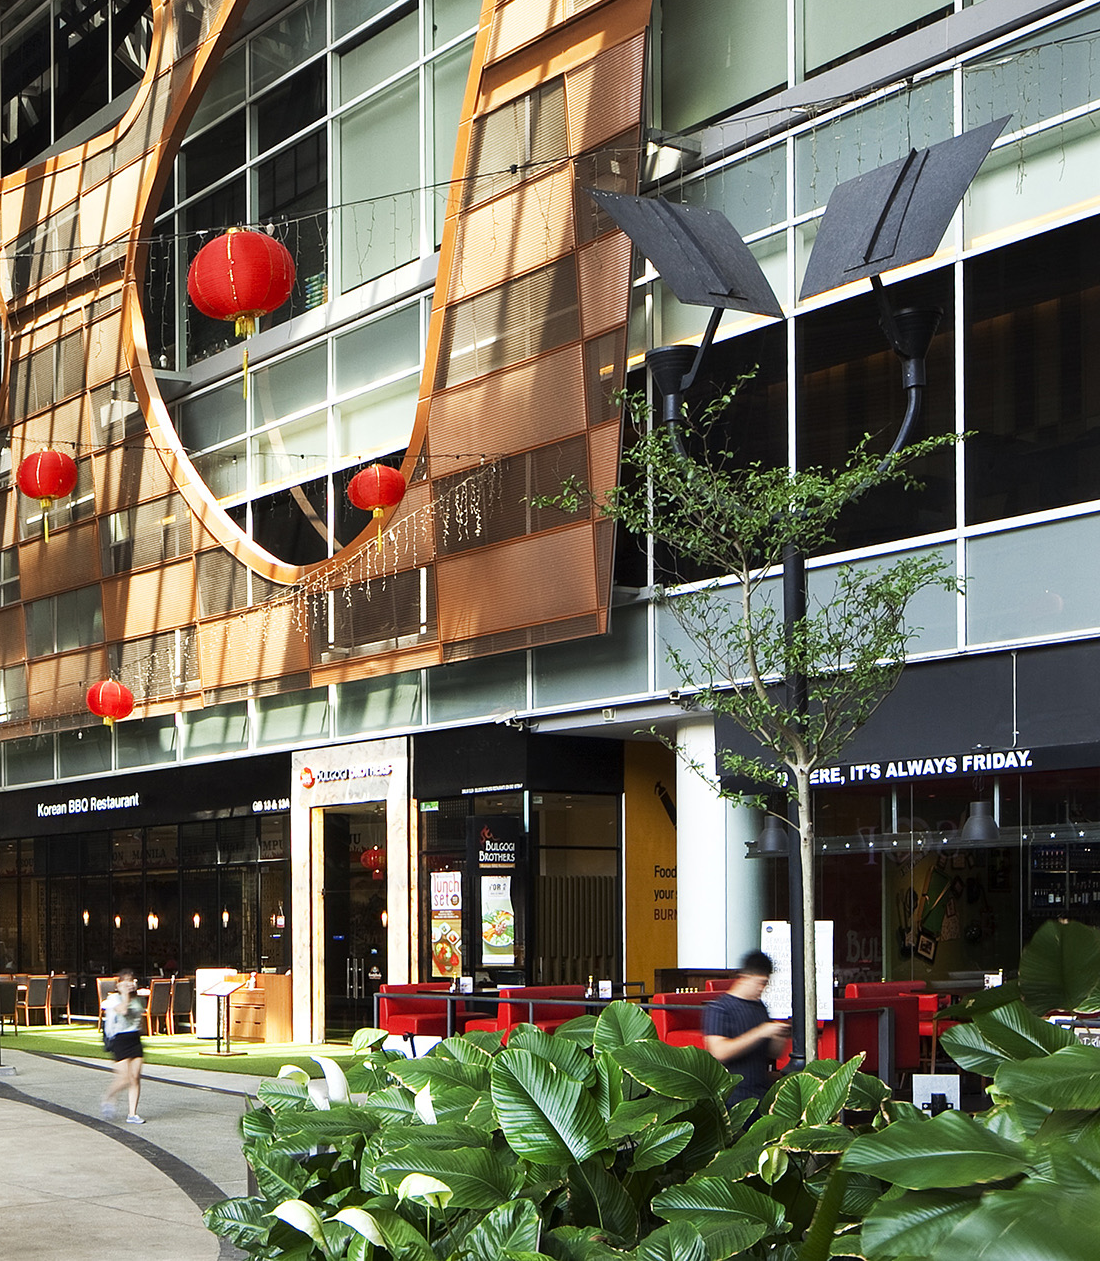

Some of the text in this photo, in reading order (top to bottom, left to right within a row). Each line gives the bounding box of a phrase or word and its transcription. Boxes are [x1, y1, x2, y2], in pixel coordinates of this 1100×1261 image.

[809, 767, 846, 785] ERE,
[850, 764, 881, 781] IT'S
[886, 757, 957, 779] ALWAYS
[962, 750, 1033, 773] FRIDAY.
[37, 793, 139, 817] Korean BBQ Restaurant
[485, 840, 515, 851] BULGOGI
[479, 850, 515, 862] BROTHERS
[654, 865, 677, 878] Food
[433, 873, 460, 893] lunch
[654, 889, 674, 902] your
